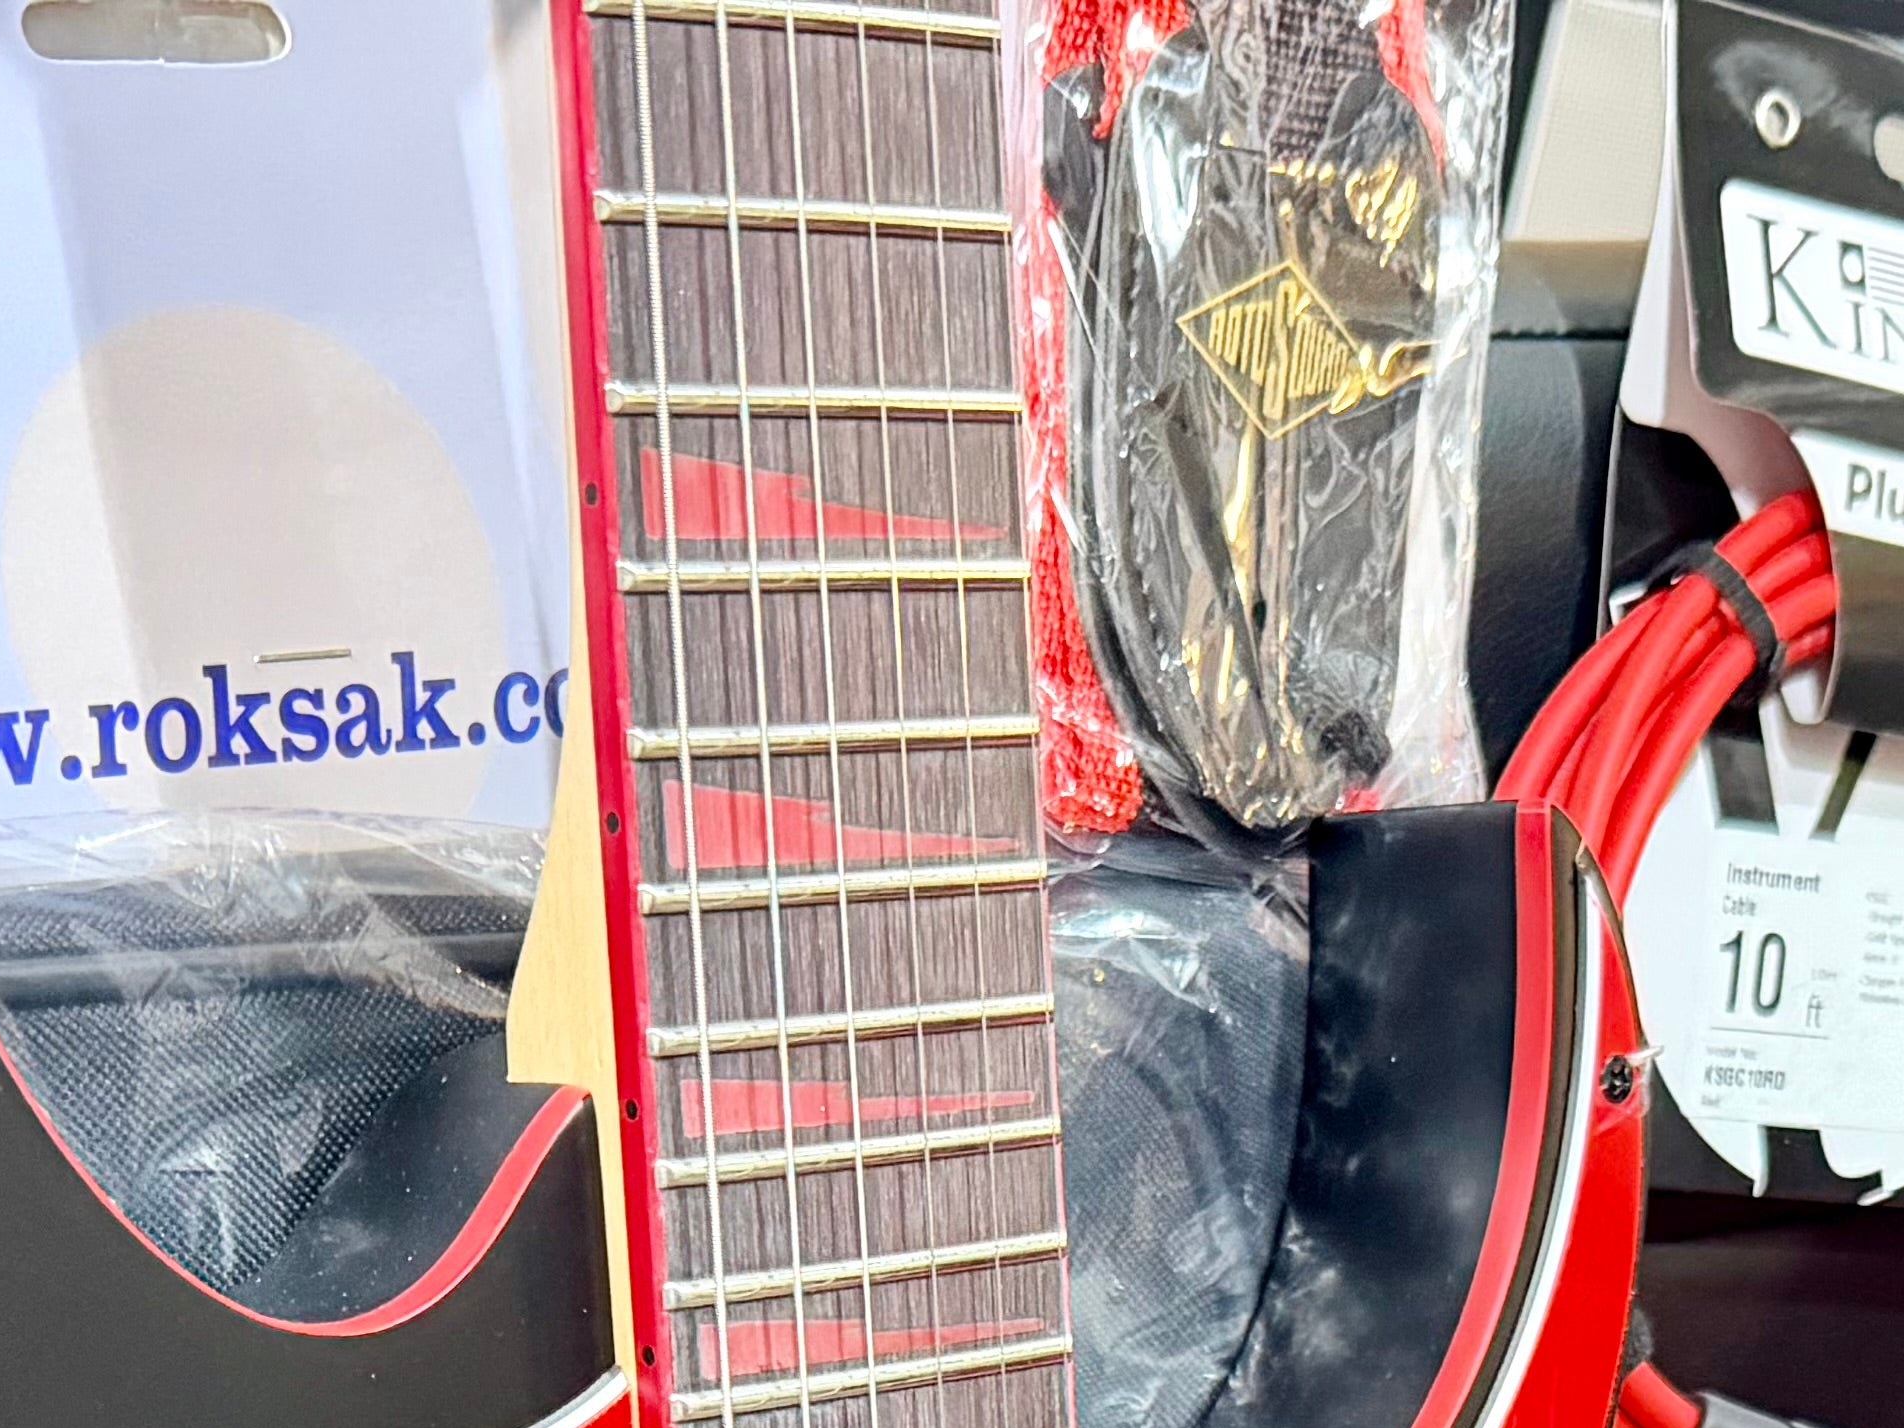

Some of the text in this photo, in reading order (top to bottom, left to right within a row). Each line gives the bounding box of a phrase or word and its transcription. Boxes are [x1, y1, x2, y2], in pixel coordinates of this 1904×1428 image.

[1727, 862, 1822, 893] Instrument
[1722, 894, 1758, 917] Cable
[1719, 929, 1786, 1018] 10
[1805, 993, 1825, 1029] ft
